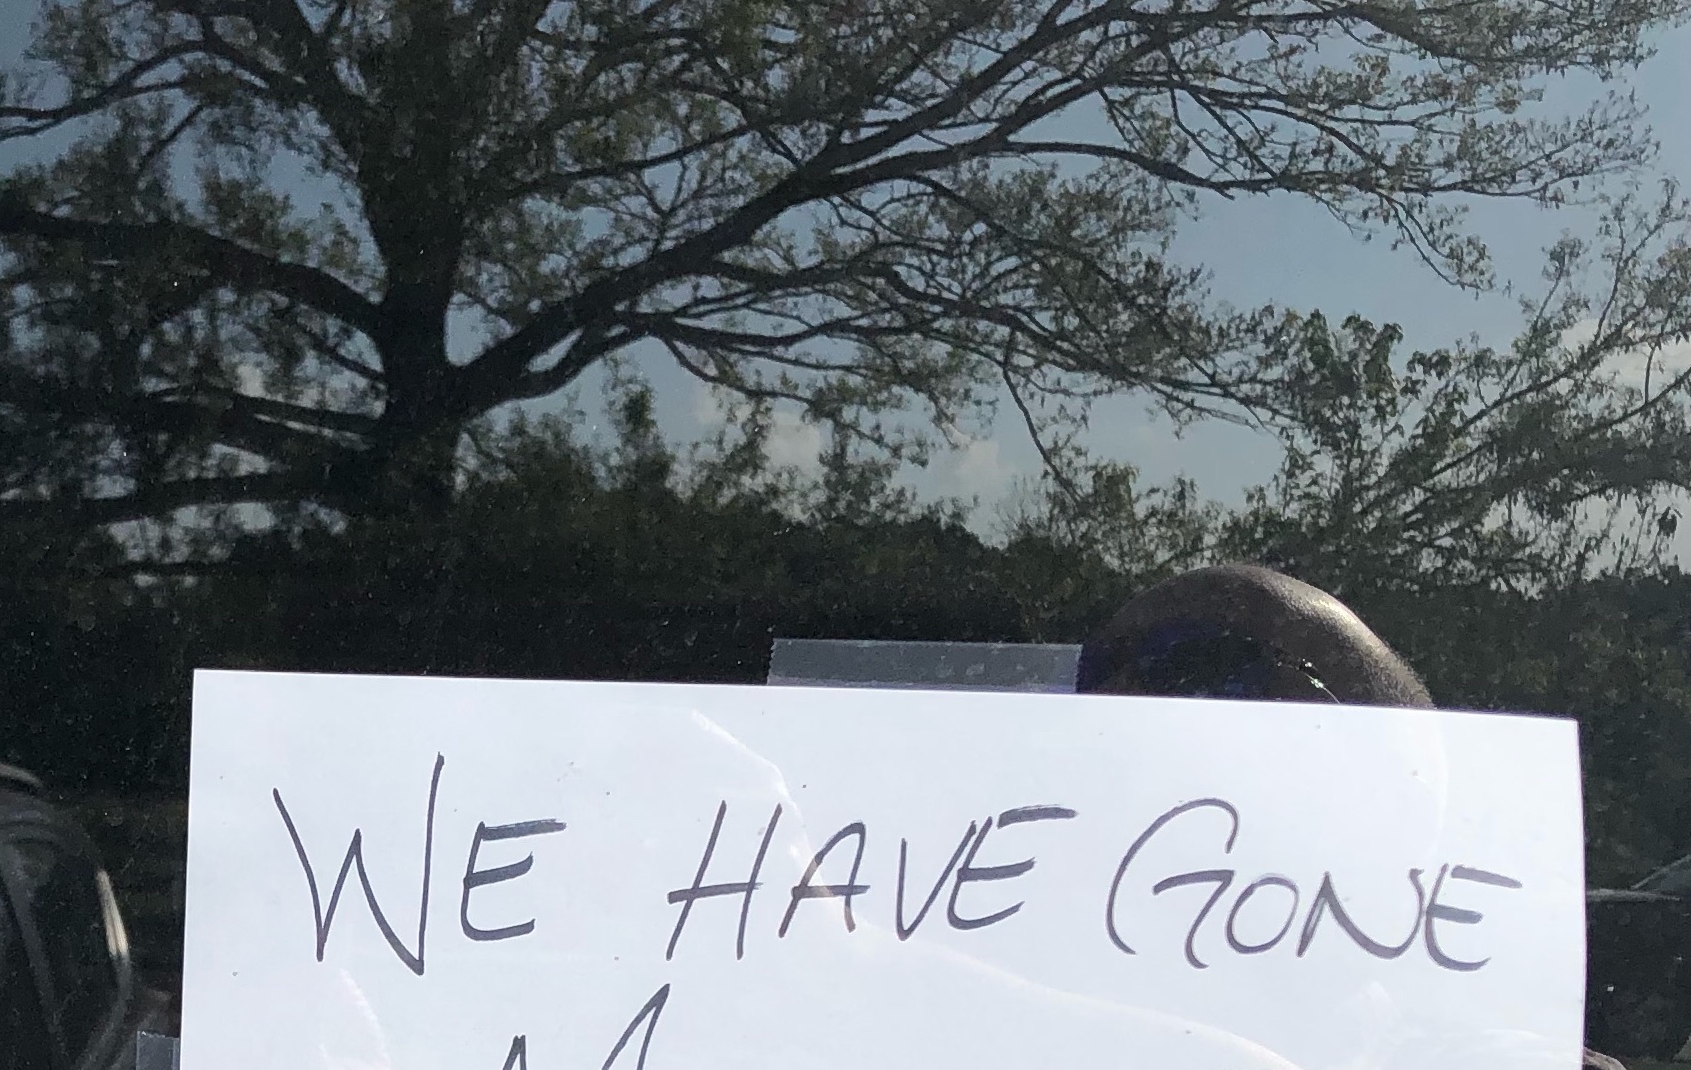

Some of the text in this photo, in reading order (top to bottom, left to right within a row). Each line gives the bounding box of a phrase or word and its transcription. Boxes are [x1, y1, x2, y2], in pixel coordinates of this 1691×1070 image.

[273, 752, 1522, 976] WE HAVE GONE
